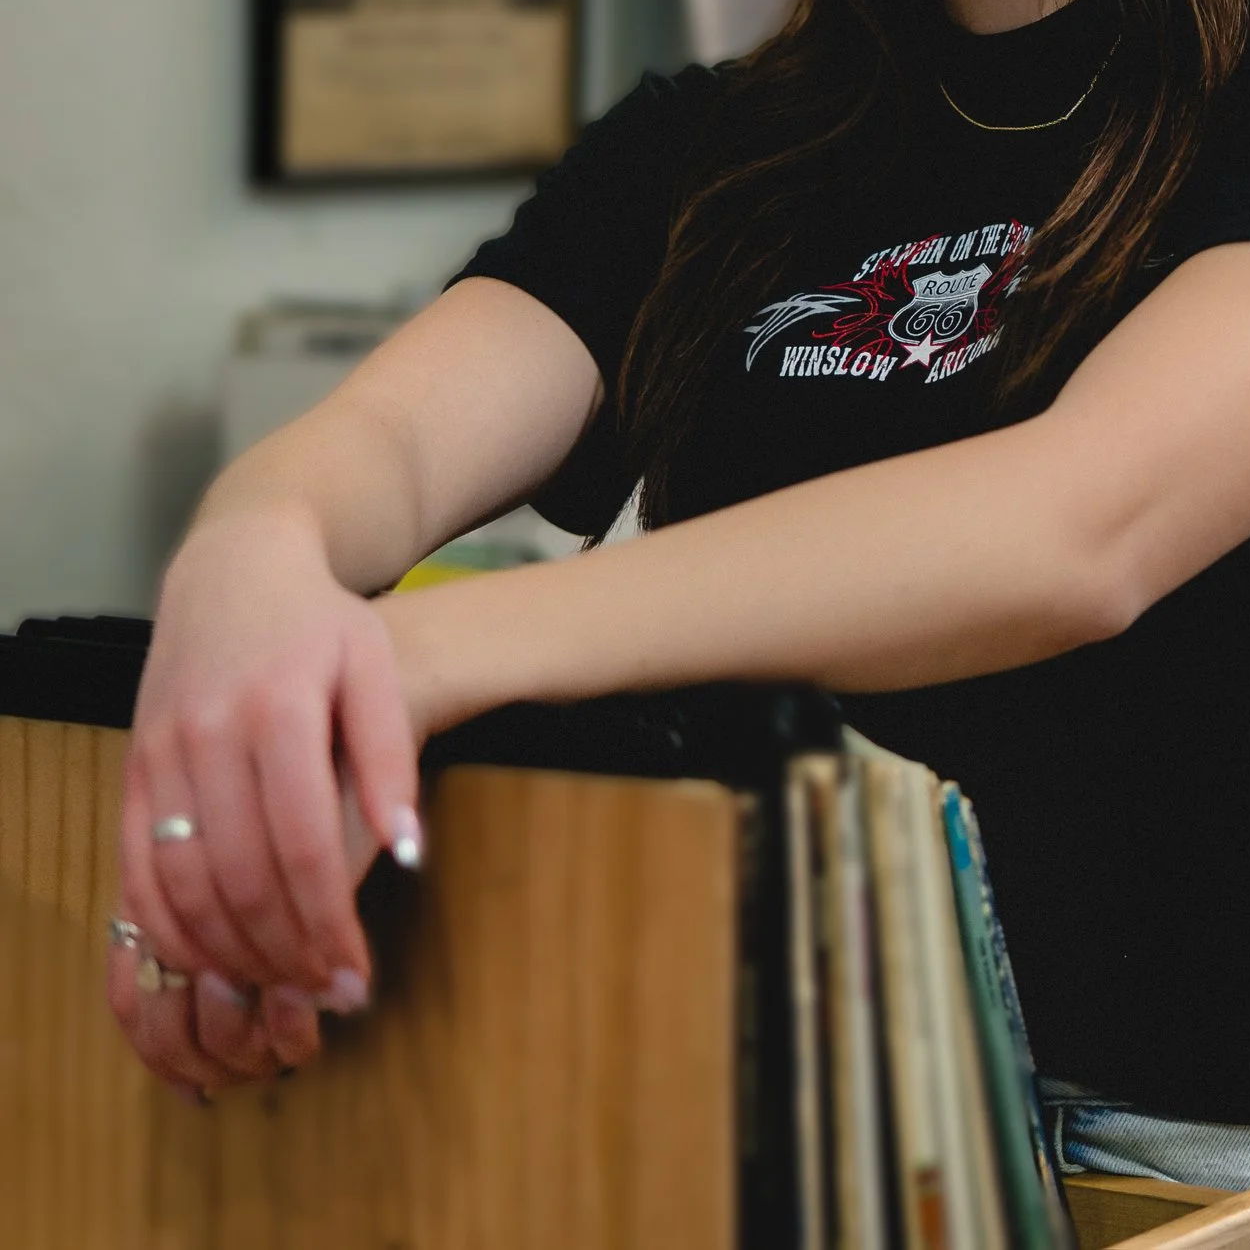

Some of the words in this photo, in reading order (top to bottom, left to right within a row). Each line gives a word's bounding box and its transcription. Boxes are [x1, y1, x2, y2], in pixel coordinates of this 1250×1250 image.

[950, 230, 979, 263] ON
[975, 224, 1006, 257] THE
[922, 272, 981, 295] ROUTE
[906, 298, 969, 337] 66
[780, 346, 898, 382] WINSLOW
